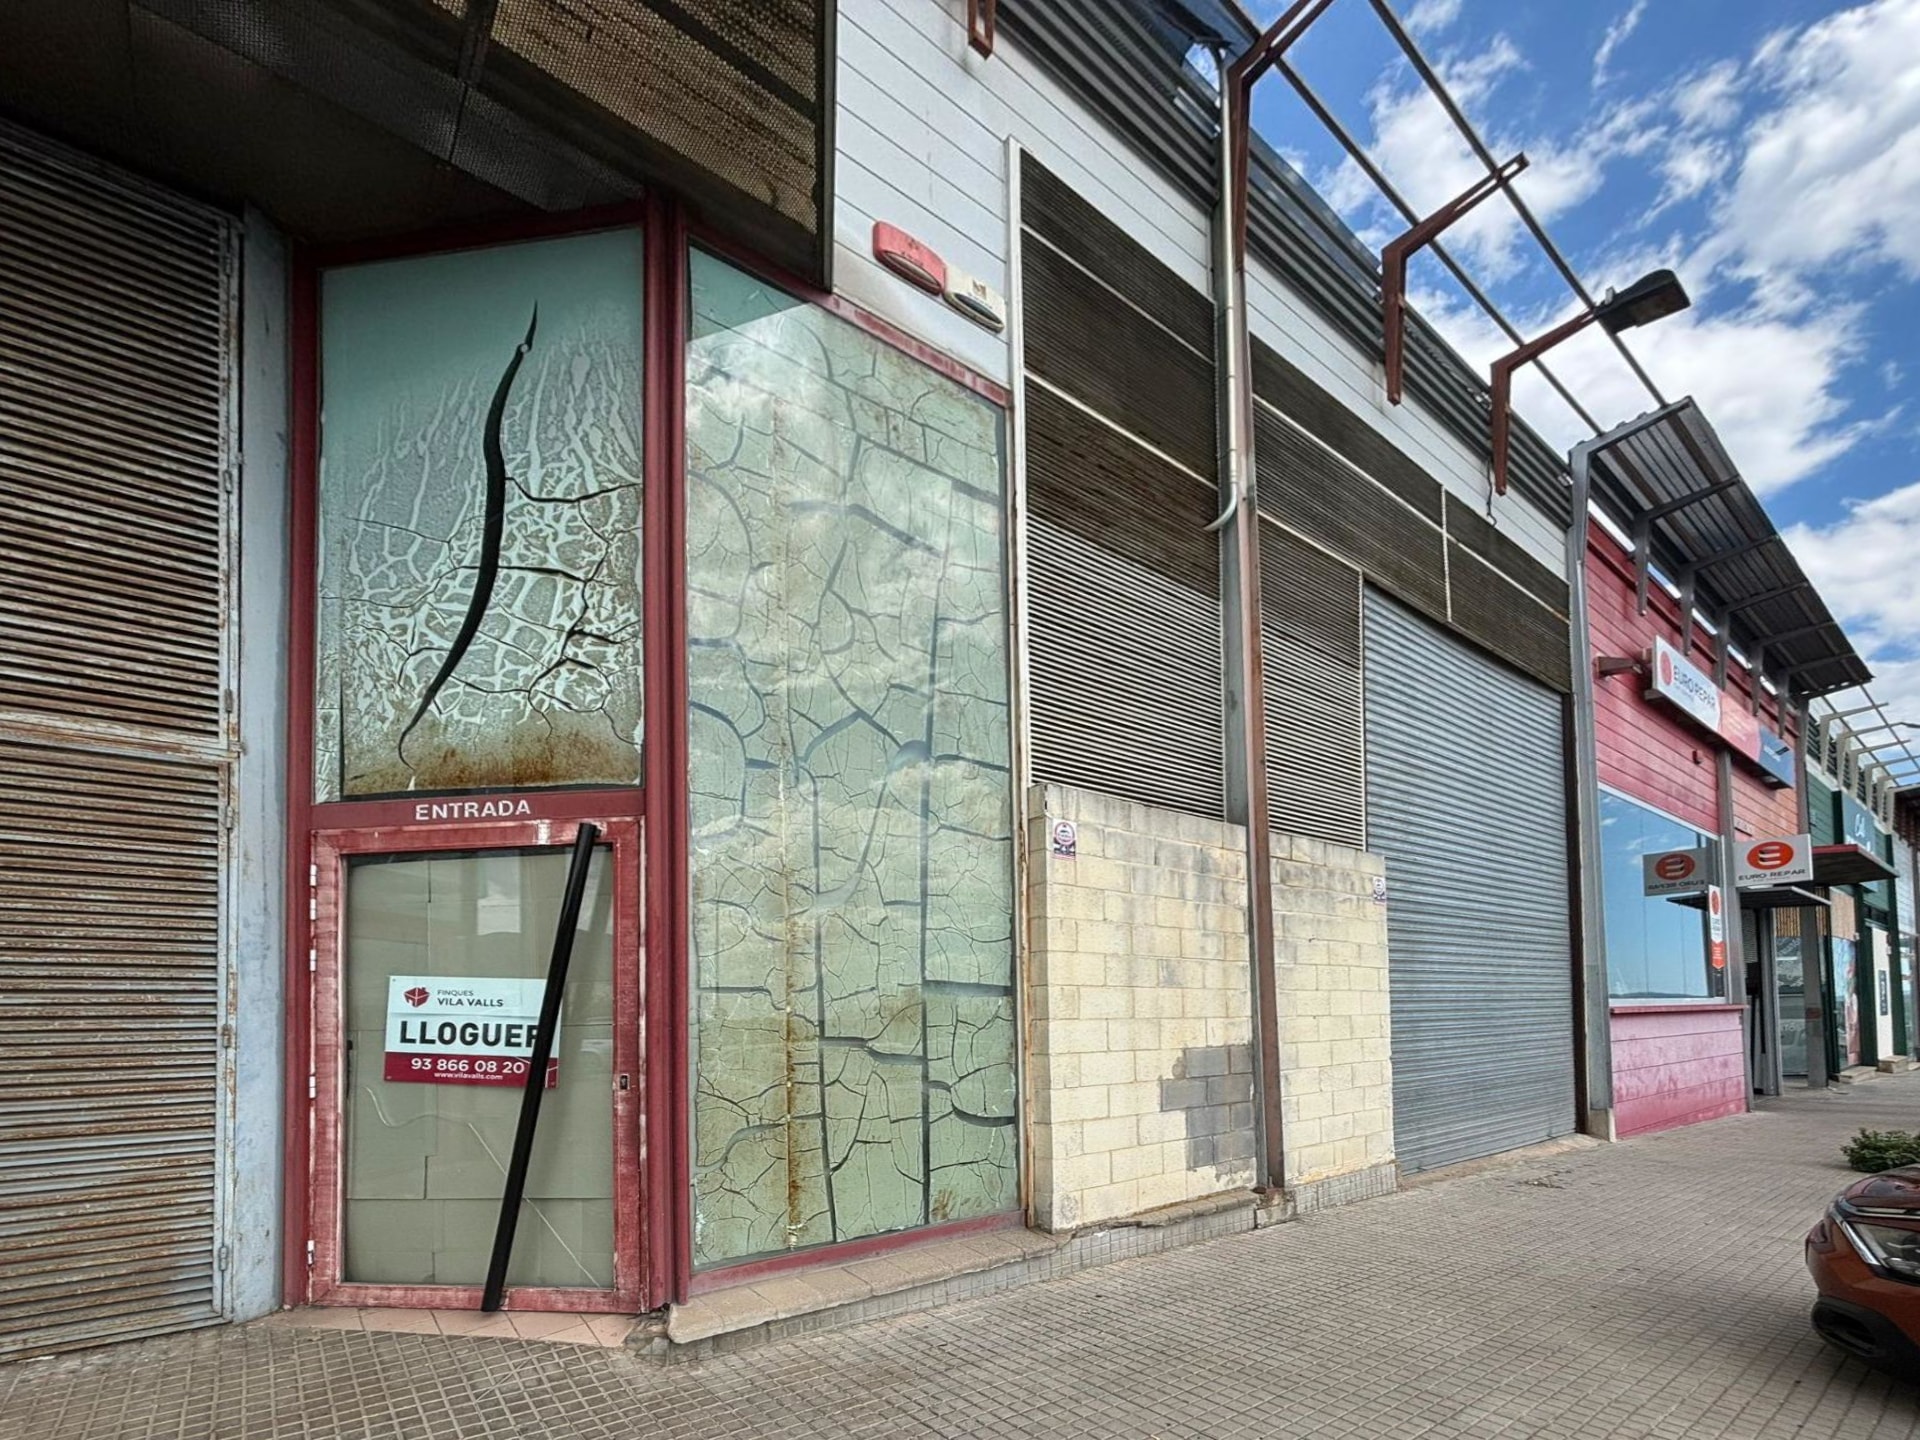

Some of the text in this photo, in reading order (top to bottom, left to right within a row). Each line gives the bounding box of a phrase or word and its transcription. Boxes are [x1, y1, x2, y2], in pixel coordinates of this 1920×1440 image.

[415, 799, 531, 821] ENTRADA
[1738, 873, 1767, 881] EURO
[1770, 868, 1806, 877] REPAR
[437, 989, 474, 997] FINQUES
[437, 997, 504, 1008] VILA VALLS
[411, 1057, 525, 1074] 93 866 08 20
[434, 1072, 503, 1080] www.vilavalls.com
